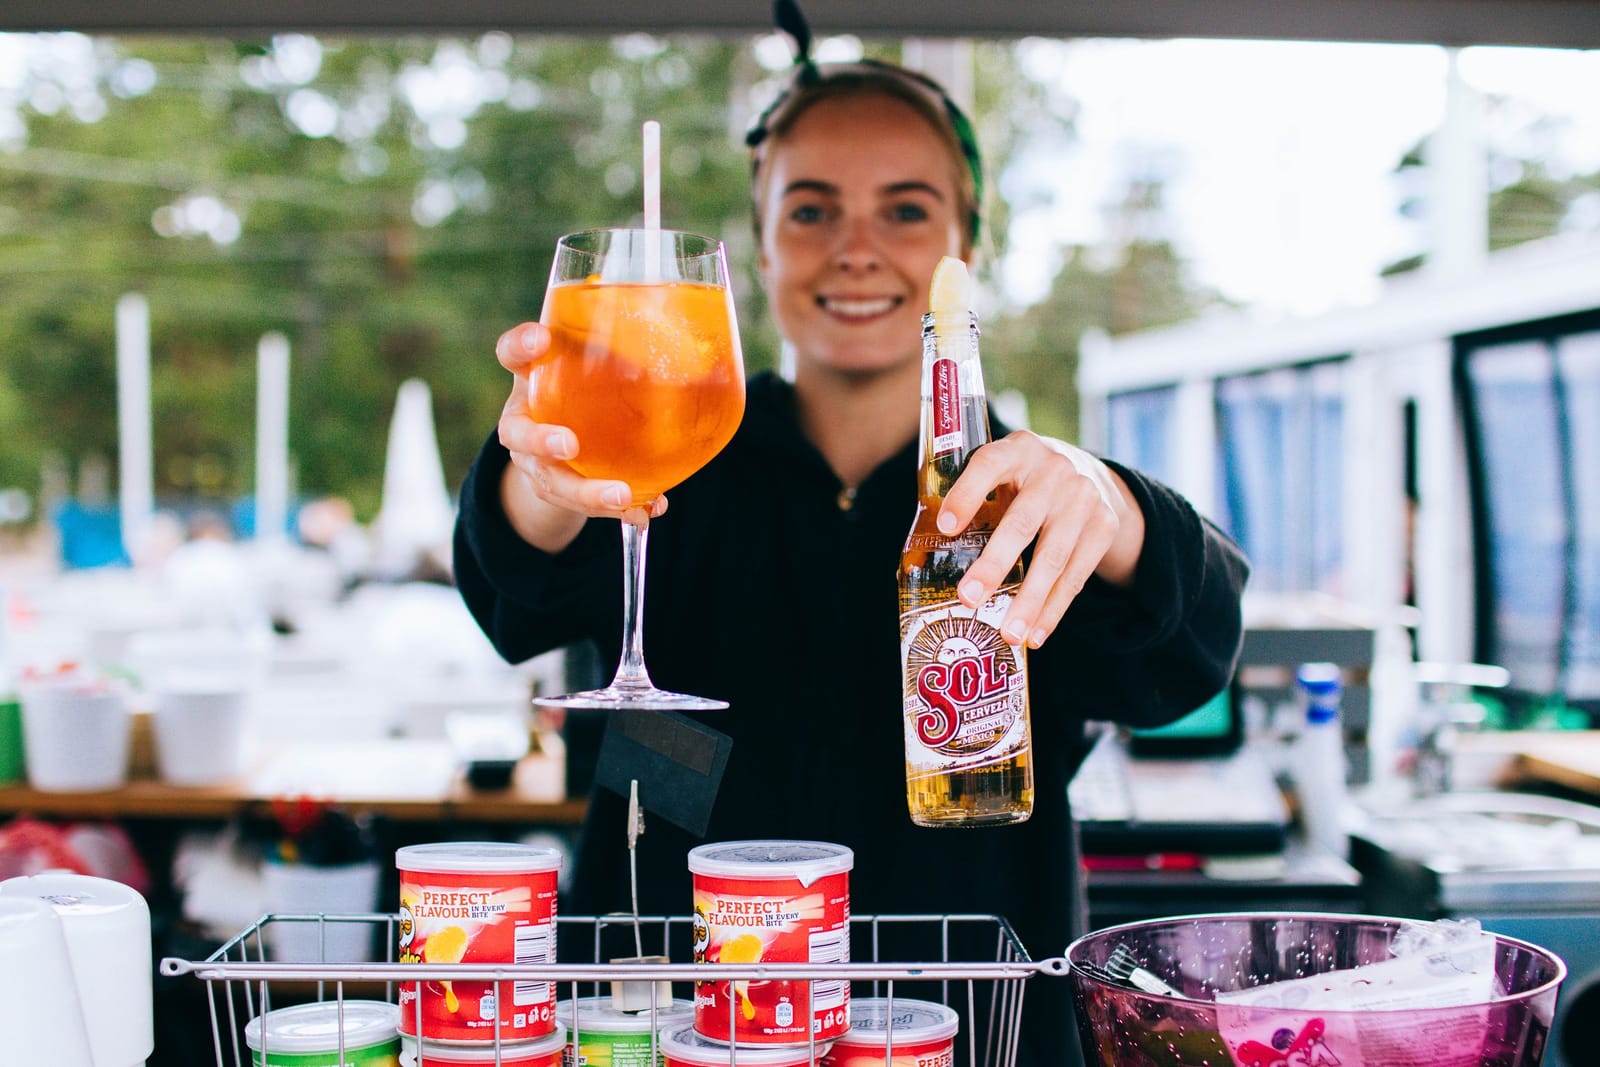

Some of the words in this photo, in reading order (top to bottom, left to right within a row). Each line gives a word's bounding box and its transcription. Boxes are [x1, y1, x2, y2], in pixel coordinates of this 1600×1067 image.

[916, 652, 1008, 748] SOL
[963, 699, 1009, 721] CERVEZA
[423, 891, 490, 906] PERFECT
[414, 905, 470, 919] FLAVOUR
[482, 904, 506, 912] EVERY
[716, 900, 784, 915] PERFECT
[708, 913, 765, 927] FLAVOUR
[776, 912, 800, 920] EVERY
